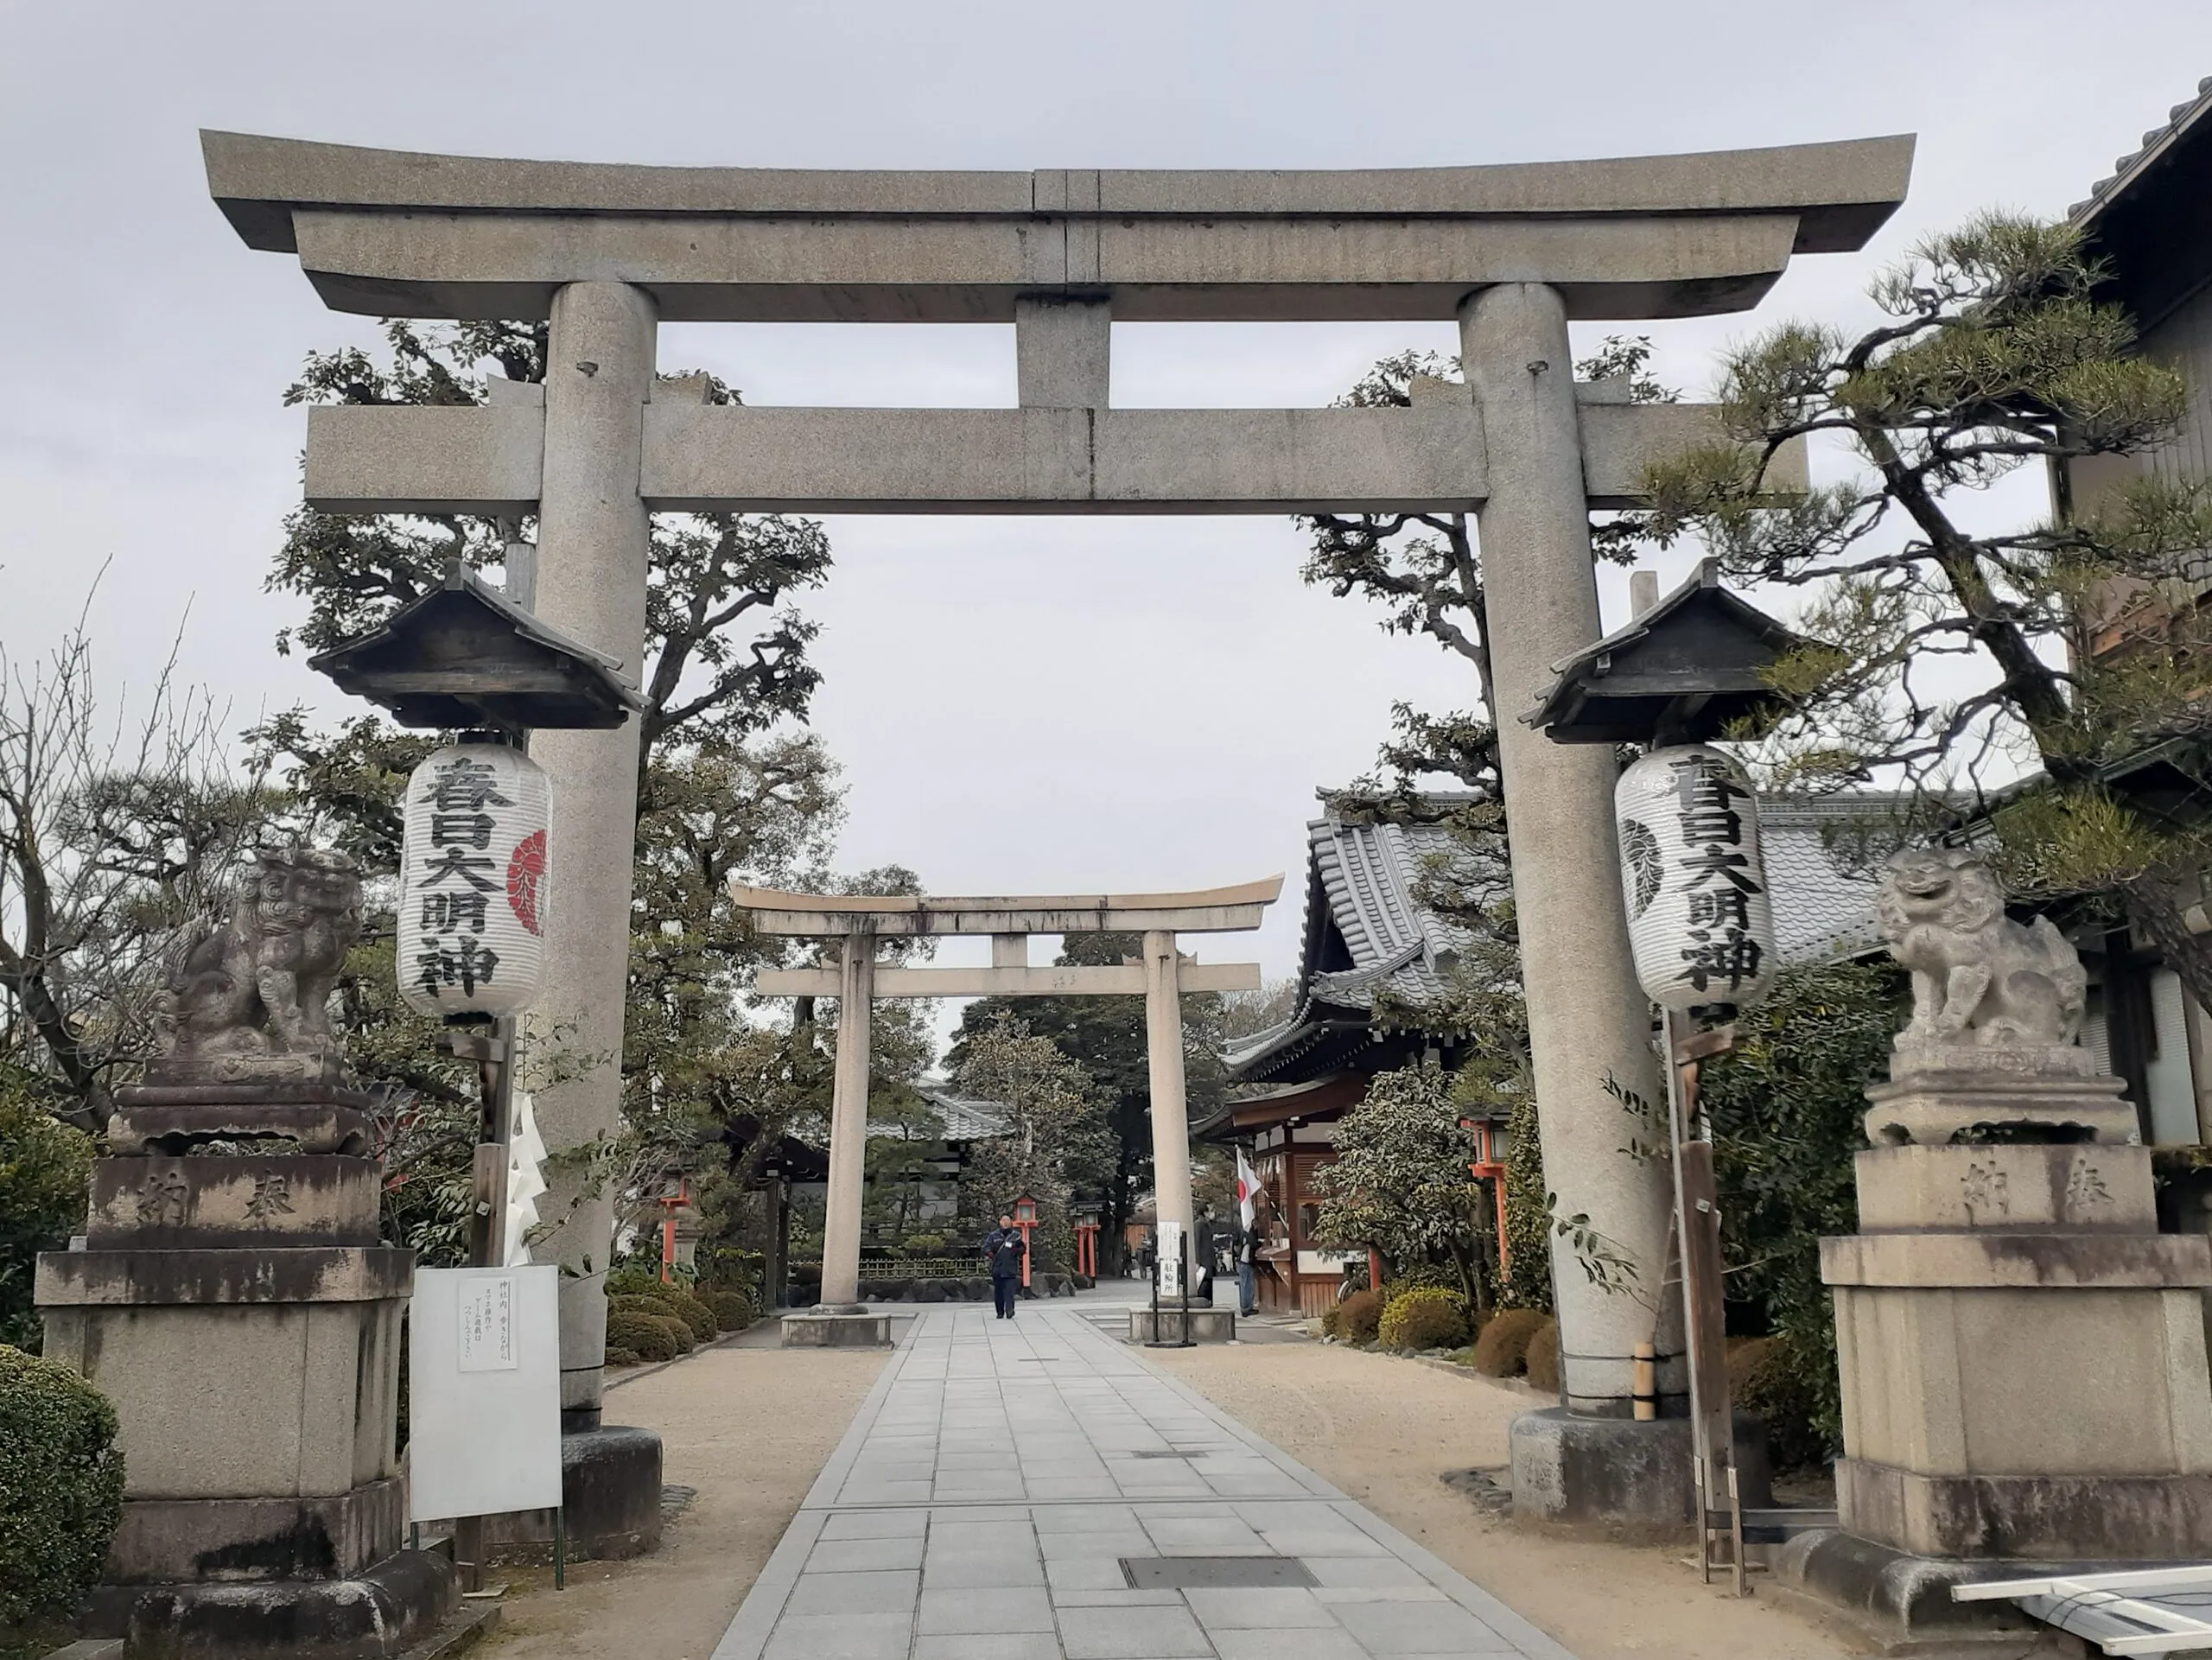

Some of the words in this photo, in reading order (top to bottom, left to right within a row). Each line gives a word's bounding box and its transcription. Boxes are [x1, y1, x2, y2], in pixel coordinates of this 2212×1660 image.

[415, 756, 518, 998] 春日大明神
[1656, 754, 1764, 992] 春日大明神
[1164, 1263, 1174, 1294] 駐輪所
